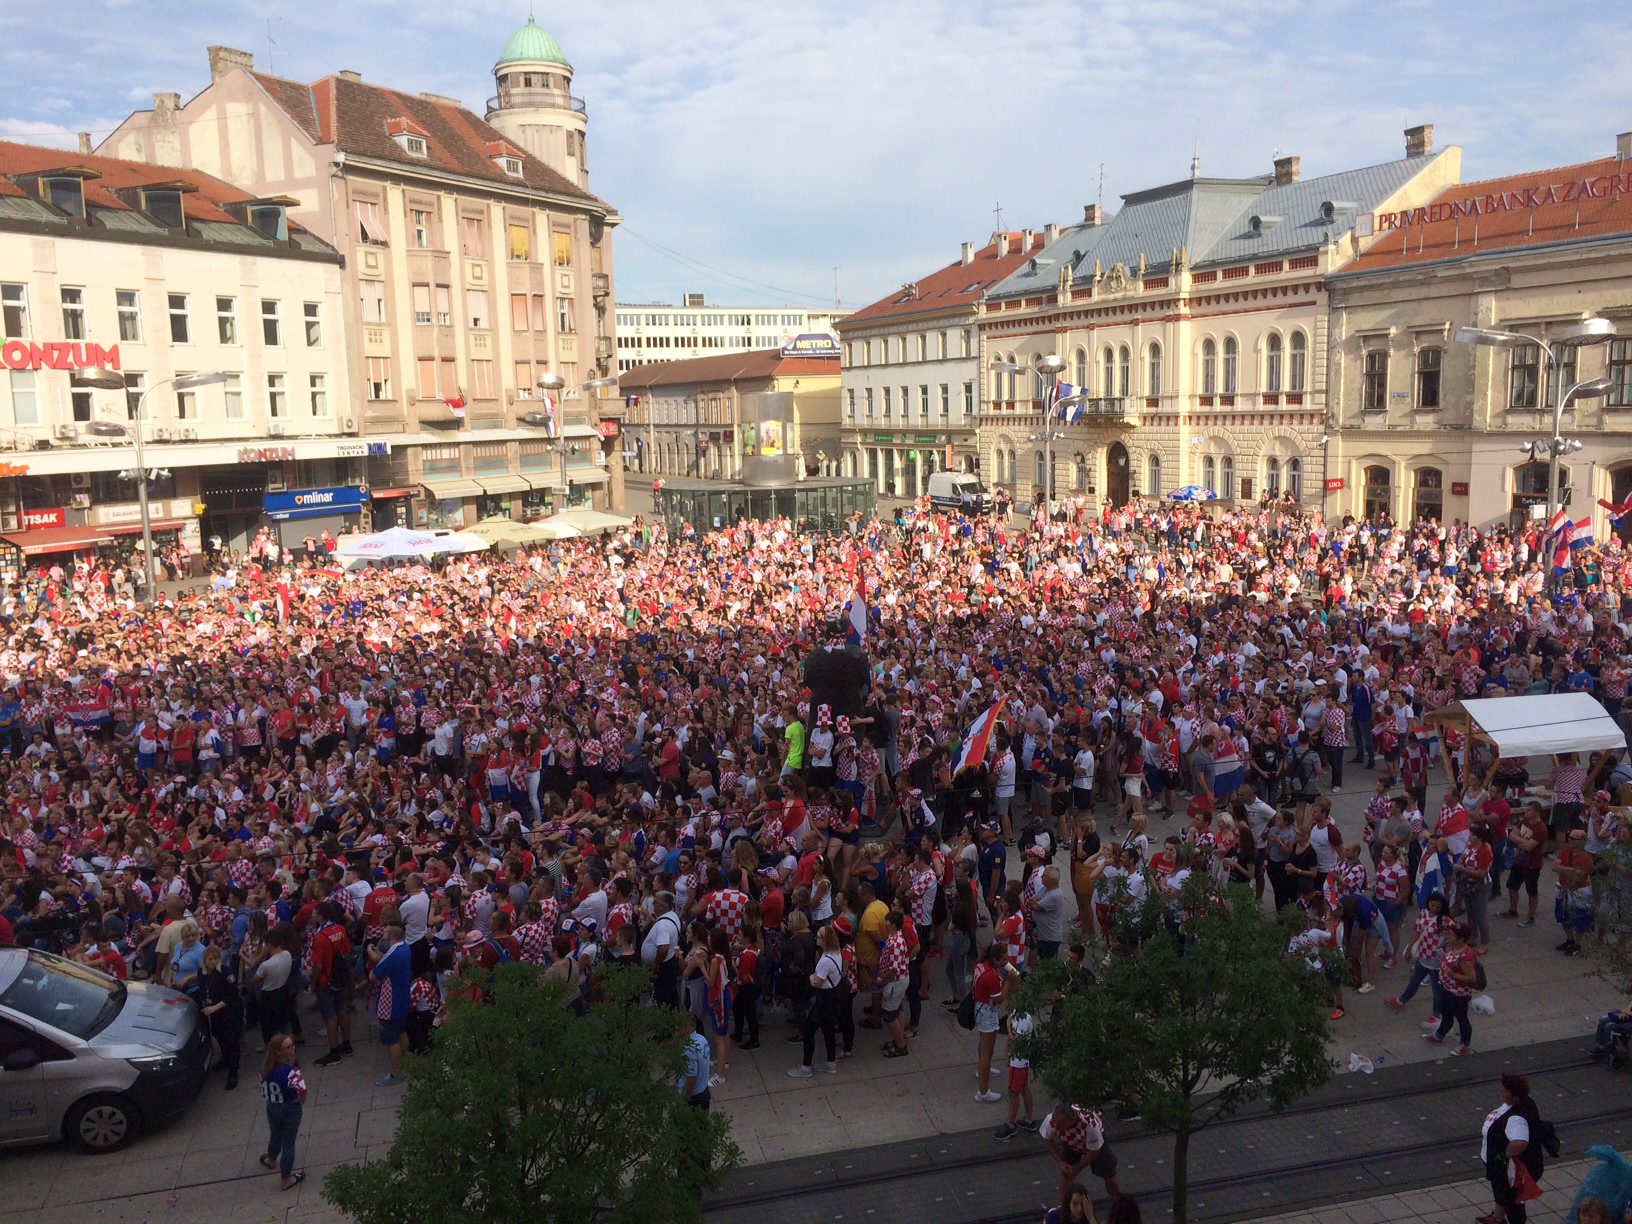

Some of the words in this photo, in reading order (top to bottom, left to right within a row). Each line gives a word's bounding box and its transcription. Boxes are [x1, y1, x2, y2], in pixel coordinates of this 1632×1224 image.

[1378, 197, 1481, 231] PRIVREDNA
[1485, 184, 1558, 214] BANKA
[796, 339, 832, 349] METRO
[237, 446, 296, 463] KONZUM
[303, 491, 334, 504] mlinar
[24, 513, 58, 525] TISAK
